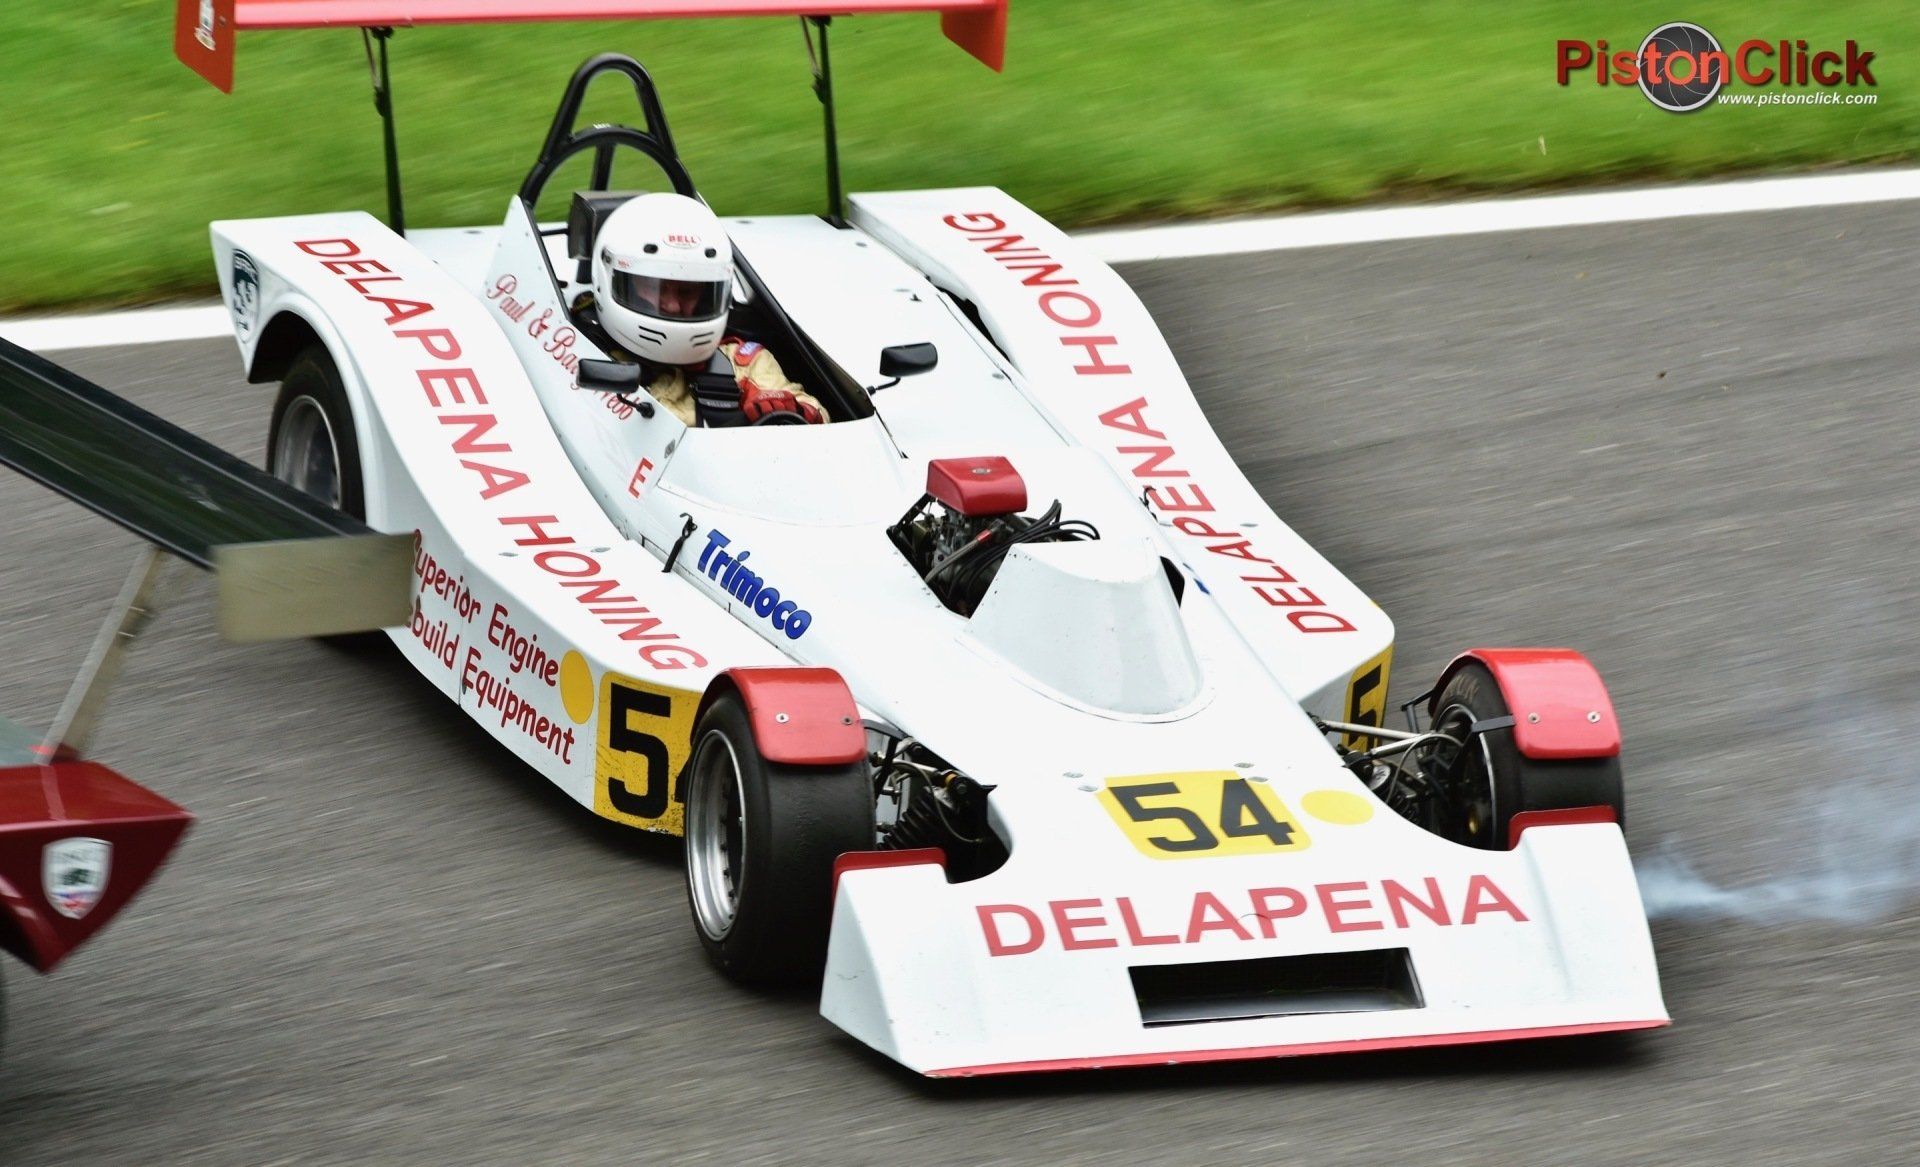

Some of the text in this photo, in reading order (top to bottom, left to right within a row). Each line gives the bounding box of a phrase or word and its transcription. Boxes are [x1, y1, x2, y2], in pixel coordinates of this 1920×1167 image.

[667, 234, 698, 244] BELL
[486, 273, 536, 324] Paul
[528, 307, 553, 339] &
[294, 237, 708, 671] DELAPENA HONING
[942, 211, 1358, 634] DELAPENA HONING
[628, 457, 654, 499] E
[696, 528, 813, 640] Trimoco
[487, 602, 560, 687] Engine
[462, 645, 576, 765] Equipment
[607, 682, 692, 820] 5
[1104, 778, 1296, 852] 54
[975, 874, 1529, 957] DELAPENA
